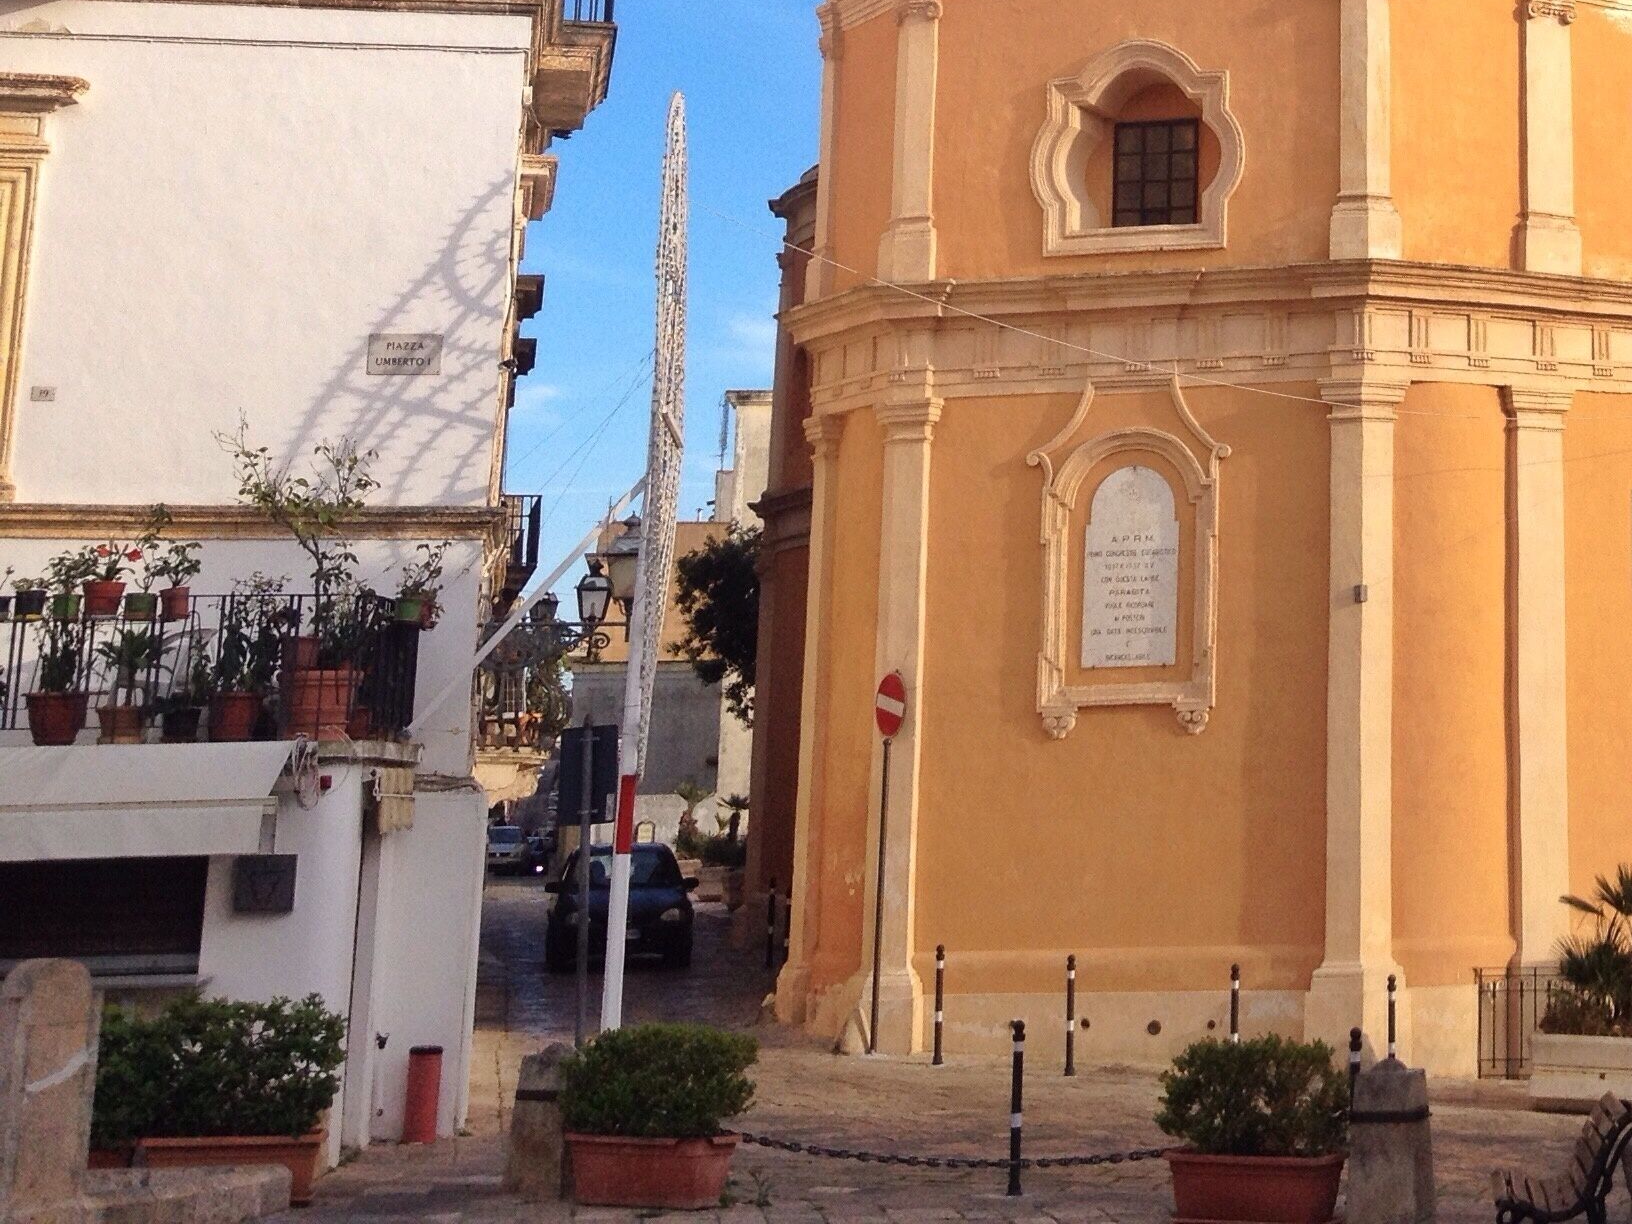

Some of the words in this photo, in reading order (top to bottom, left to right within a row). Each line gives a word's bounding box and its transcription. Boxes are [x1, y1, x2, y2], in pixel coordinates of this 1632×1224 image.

[386, 341, 424, 351] PIAZZA
[375, 357, 425, 366] UMBERTO
[427, 357, 431, 366] I
